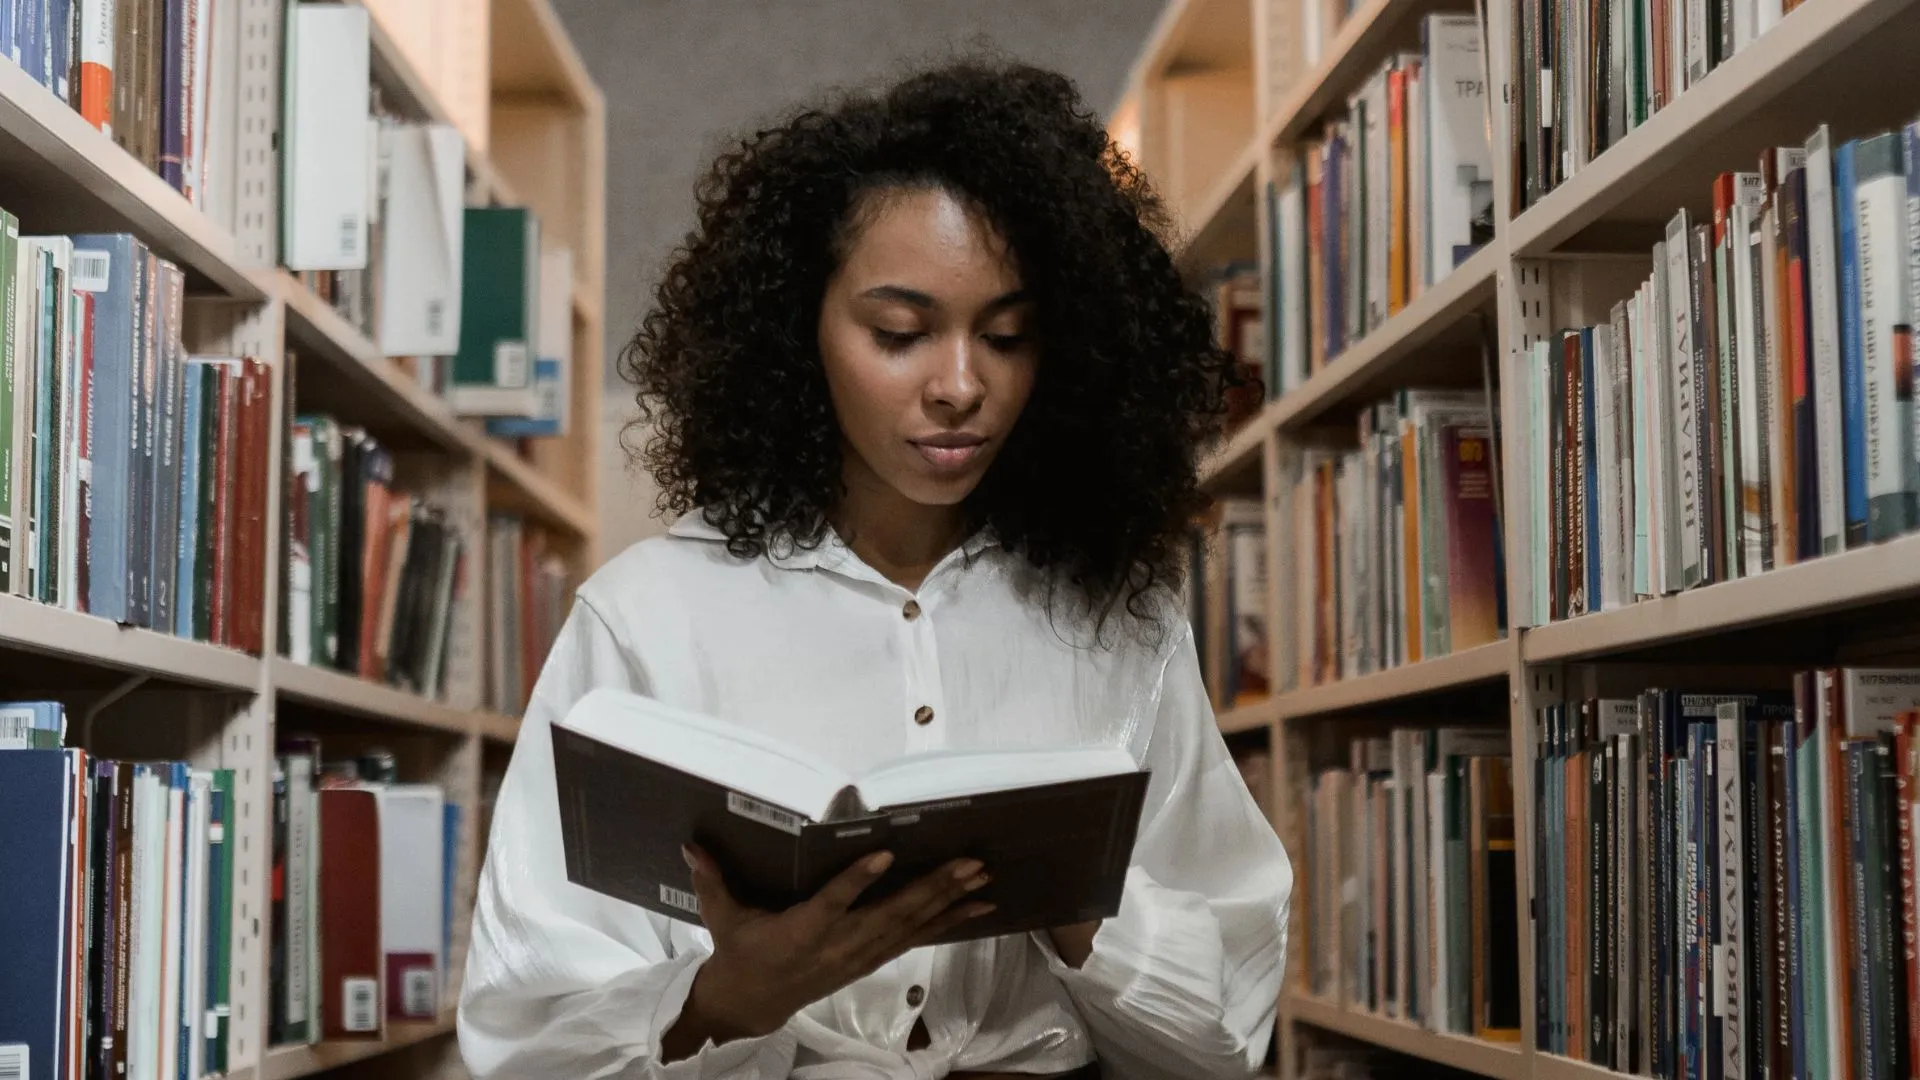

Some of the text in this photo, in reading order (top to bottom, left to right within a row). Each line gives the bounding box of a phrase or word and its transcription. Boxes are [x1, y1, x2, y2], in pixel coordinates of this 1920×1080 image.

[1676, 311, 1696, 529] НОТАРИАТ
[1723, 776, 1741, 1075] АДВОКАТУРА
[1773, 799, 1785, 935] АДВОКАТУРА
